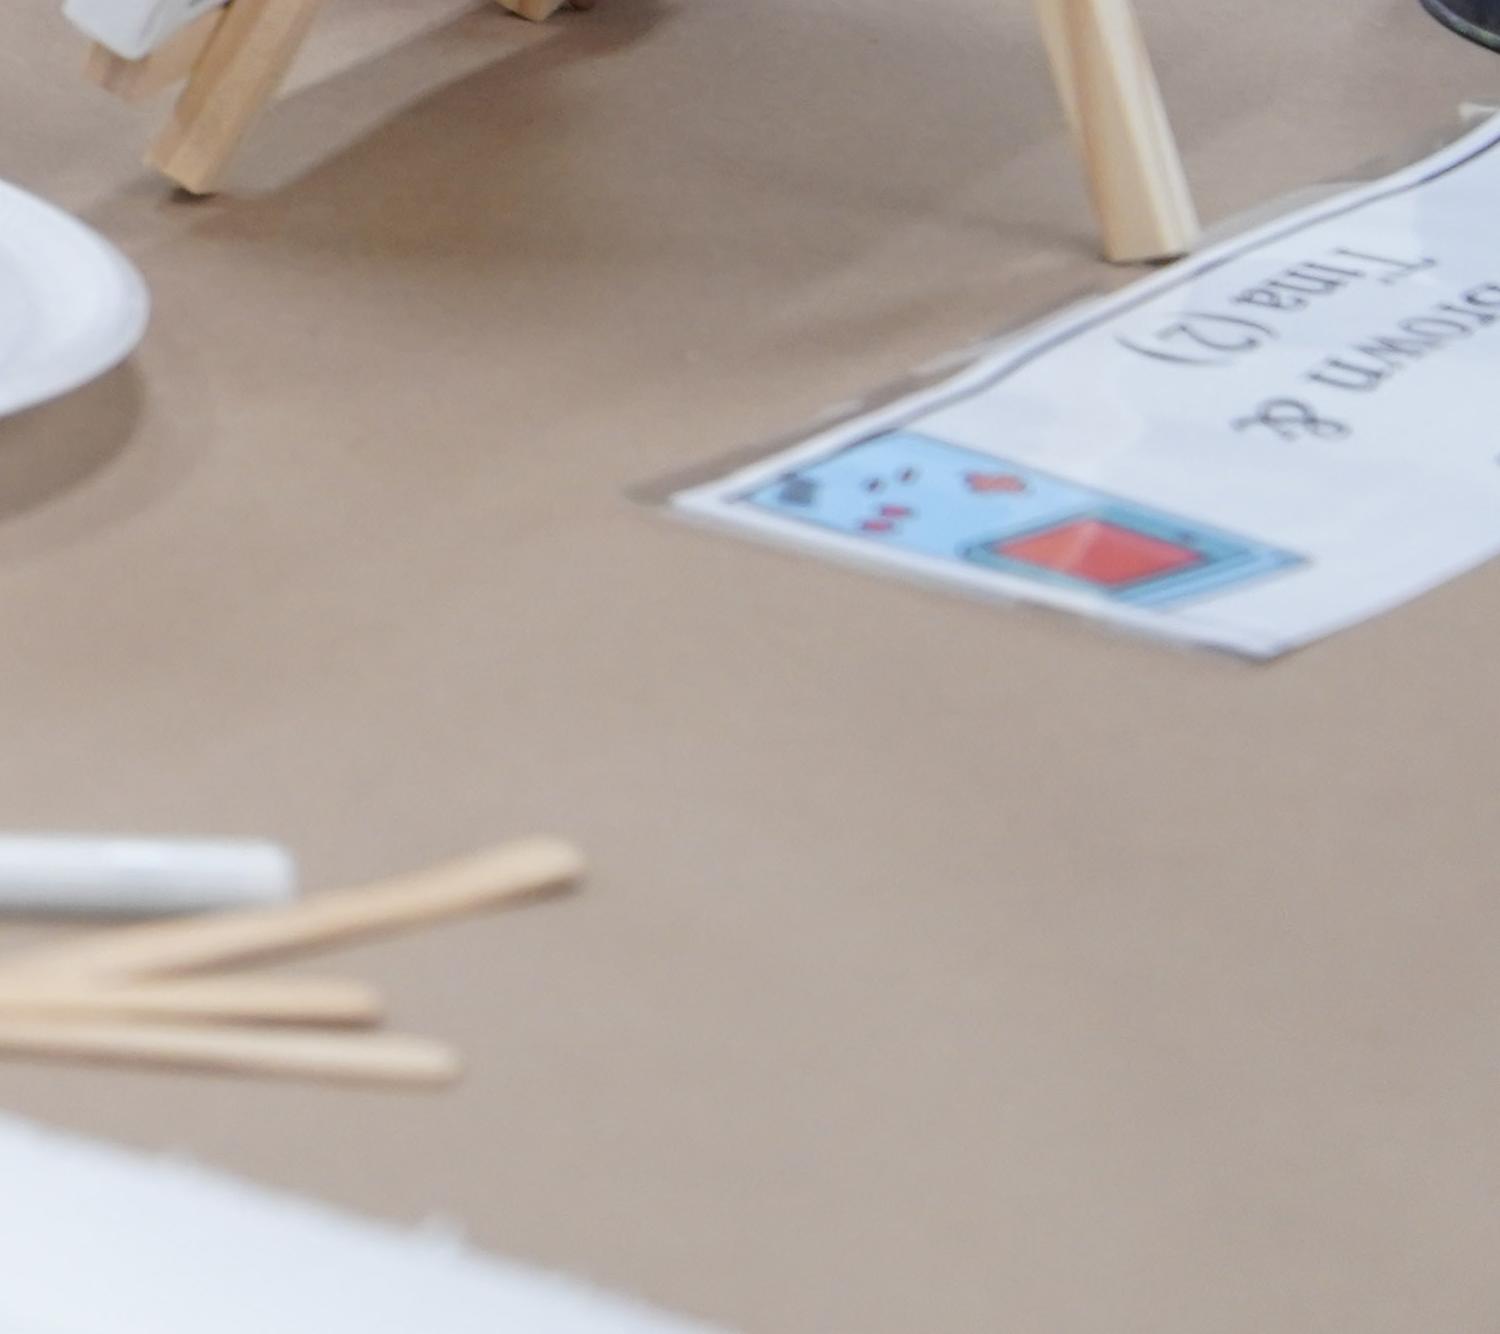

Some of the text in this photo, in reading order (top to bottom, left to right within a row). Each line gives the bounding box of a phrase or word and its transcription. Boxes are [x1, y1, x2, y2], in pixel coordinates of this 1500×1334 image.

[1116, 247, 1438, 366] Tina (2)
[1232, 397, 1352, 441] &
